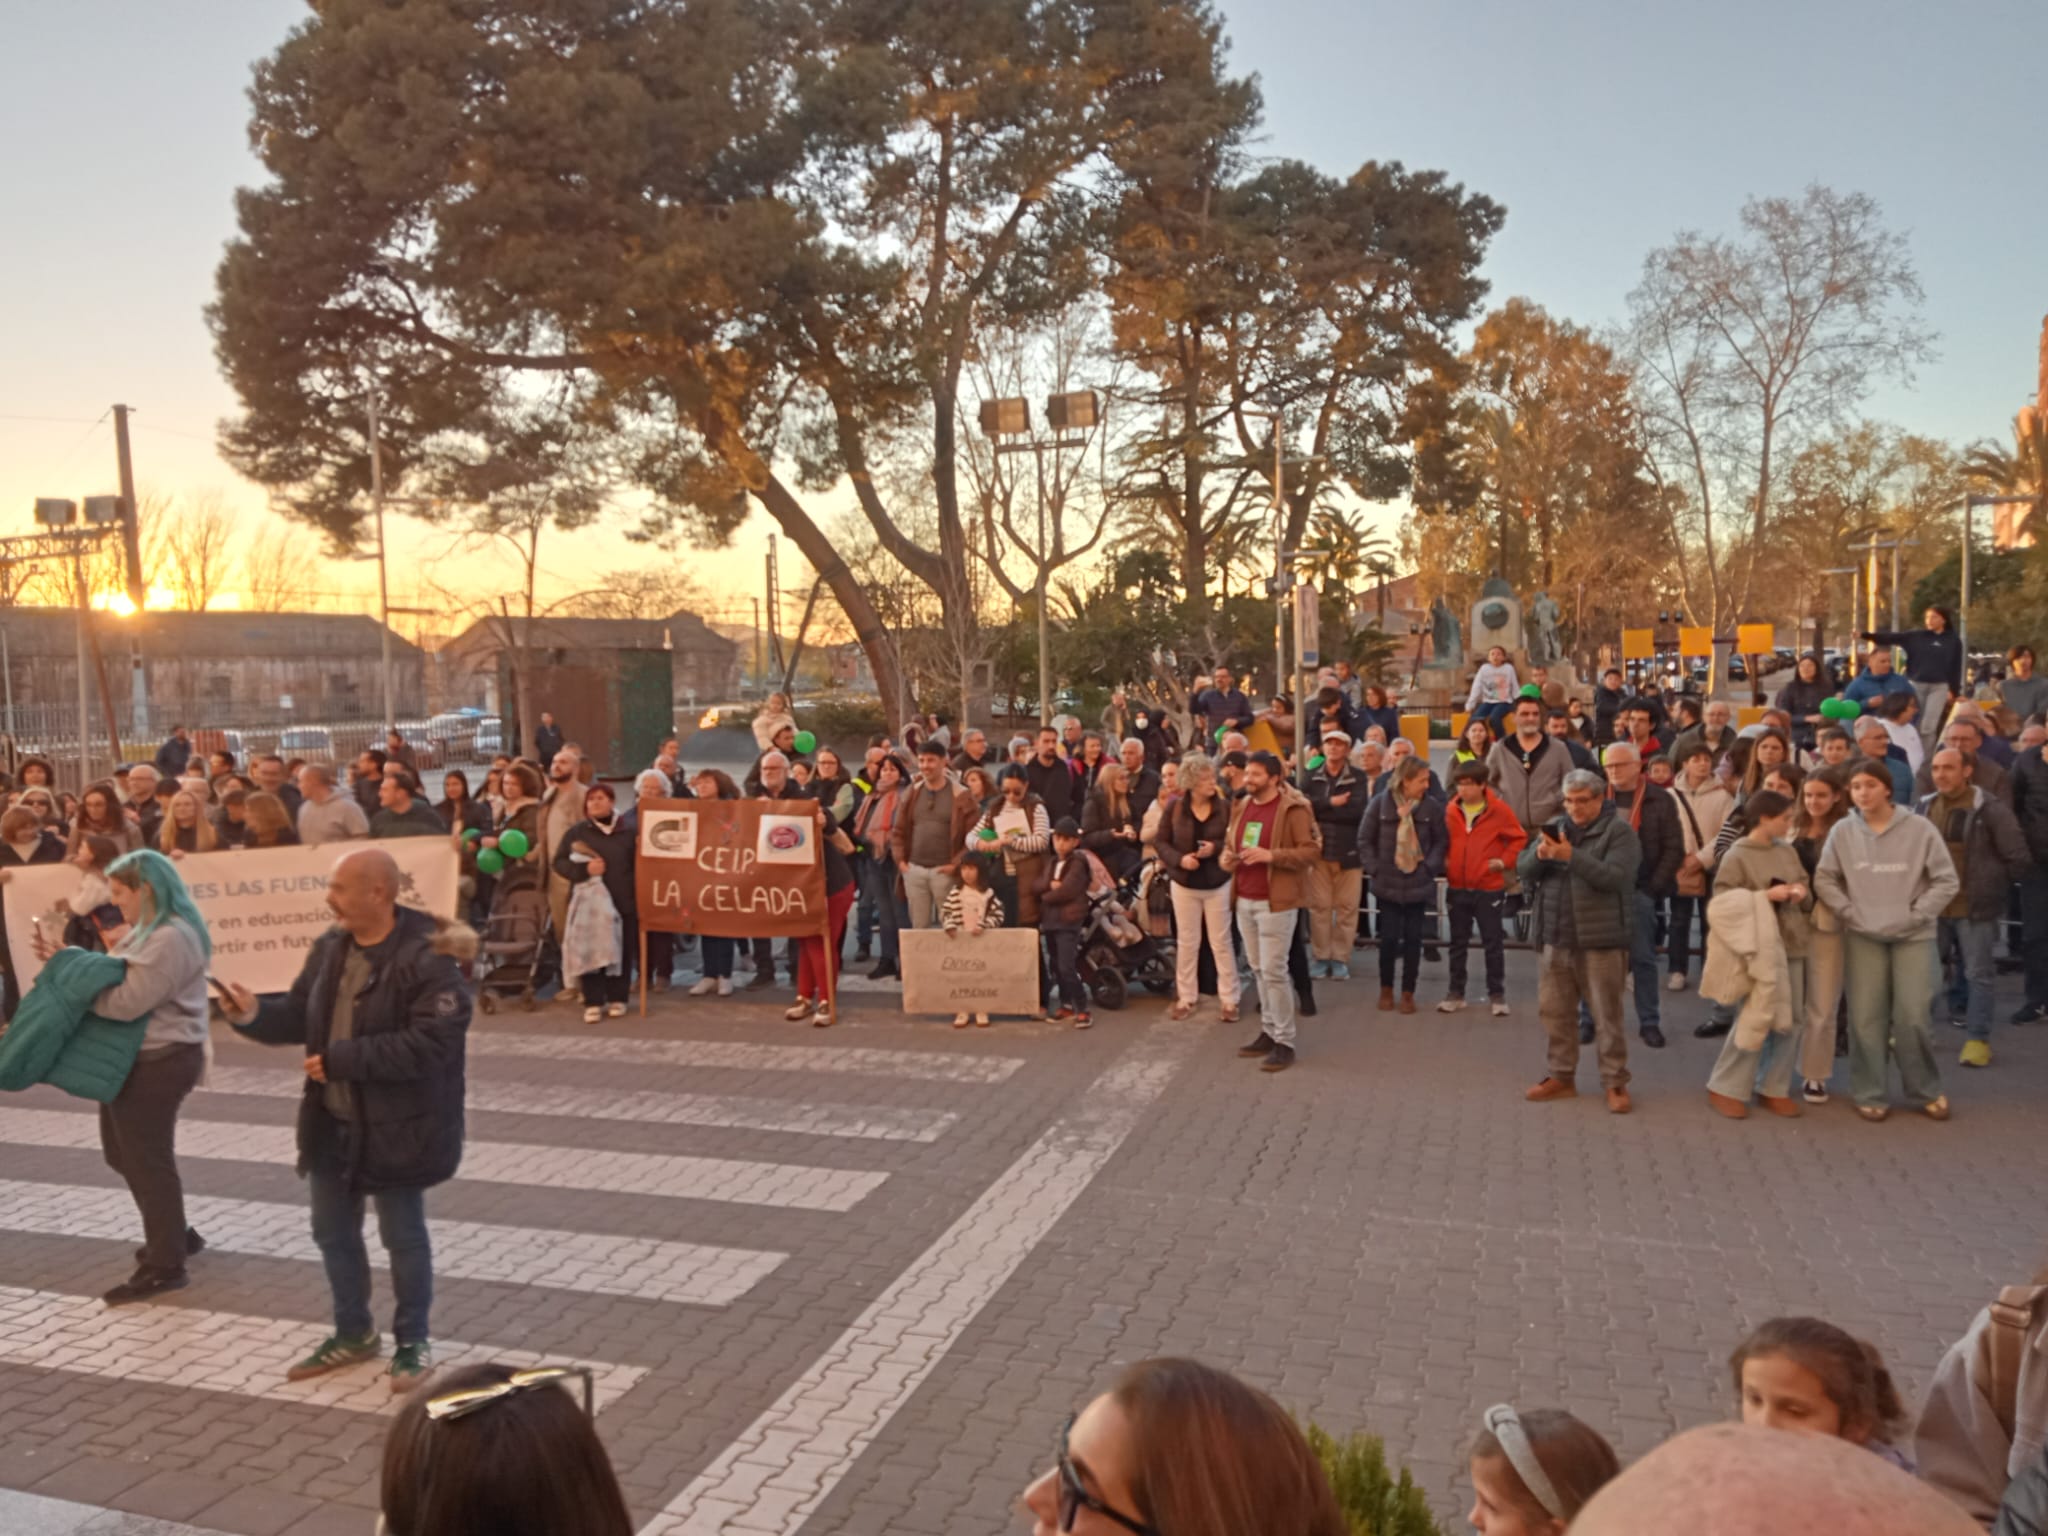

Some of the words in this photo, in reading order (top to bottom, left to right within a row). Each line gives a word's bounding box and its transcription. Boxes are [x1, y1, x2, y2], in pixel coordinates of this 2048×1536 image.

[224, 879, 265, 897] LAS
[270, 875, 329, 894] FUEN
[652, 880, 681, 908] LA
[699, 884, 807, 915] CELADA
[218, 918, 242, 930] en
[248, 907, 336, 928] educació
[212, 938, 248, 955] ertir
[253, 939, 277, 952] en
[282, 935, 315, 949] fut
